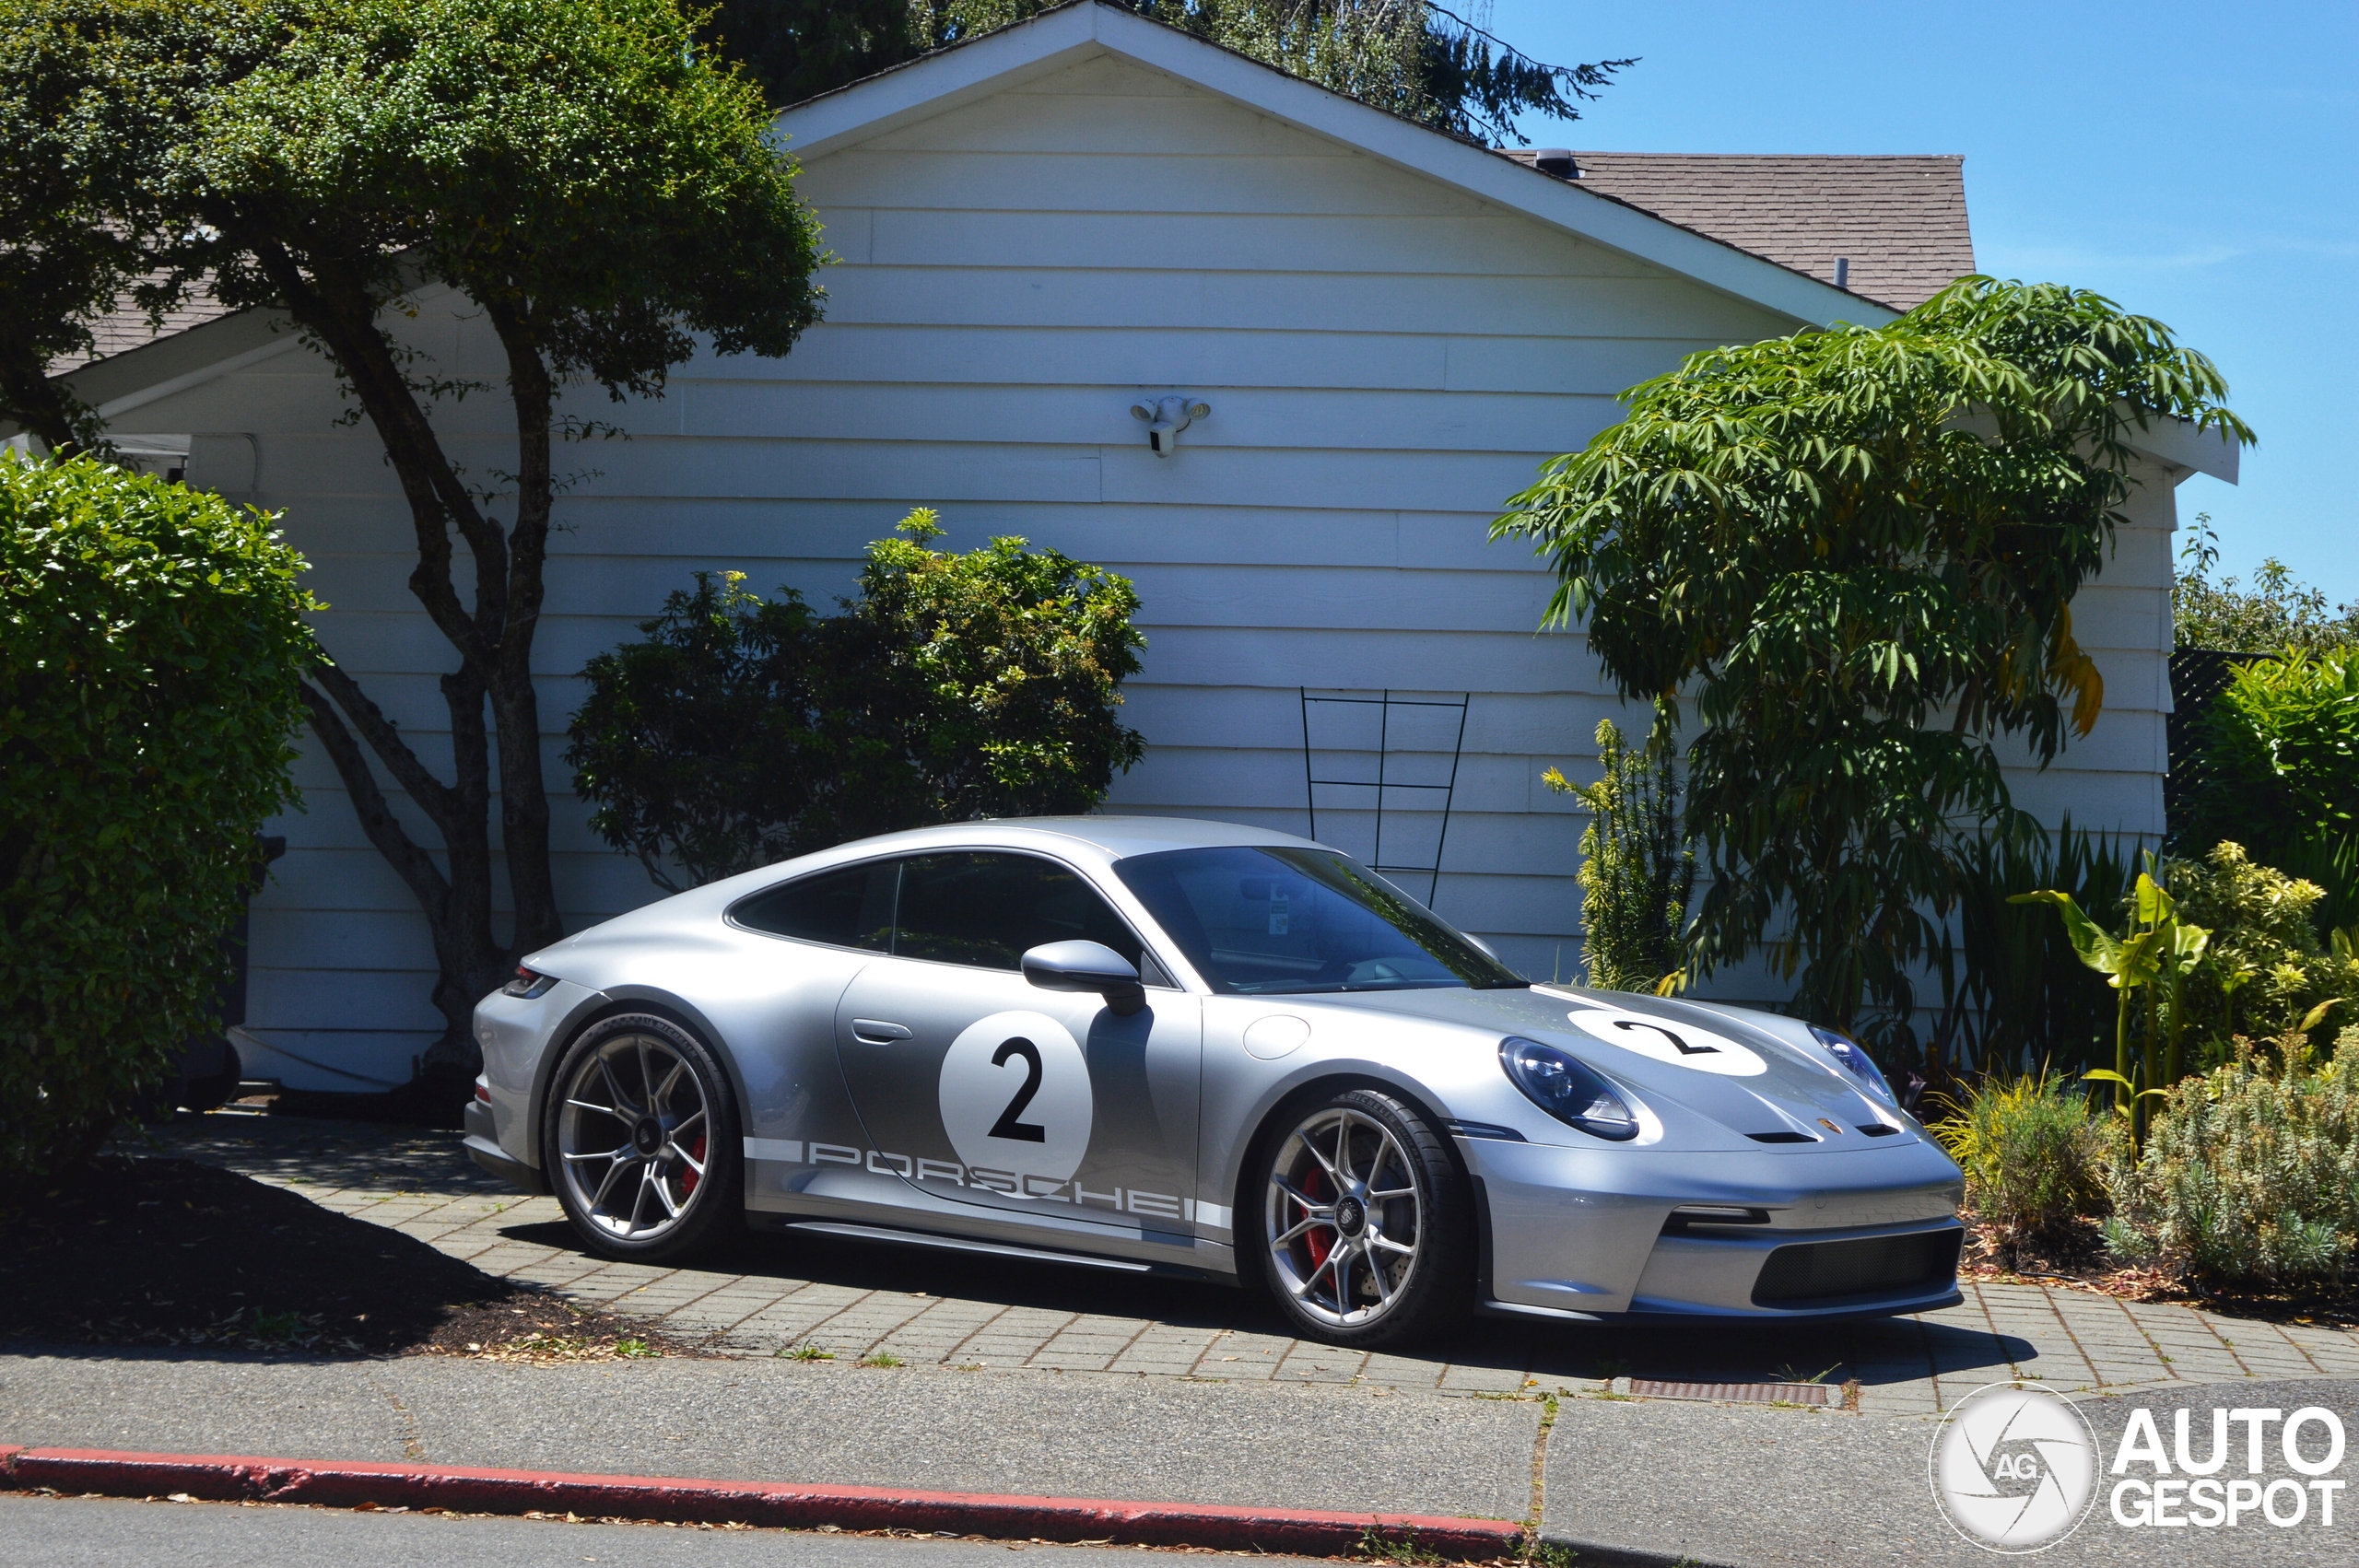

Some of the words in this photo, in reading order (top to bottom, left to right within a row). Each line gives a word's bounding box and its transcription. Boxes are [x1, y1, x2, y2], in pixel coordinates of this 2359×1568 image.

[655, 1022, 698, 1059] MICHELIN
[1613, 1021, 1724, 1055] 2
[987, 1036, 1046, 1143] 2
[1347, 1092, 1398, 1123] MICHELIN
[809, 1141, 1180, 1220] PORSCHE
